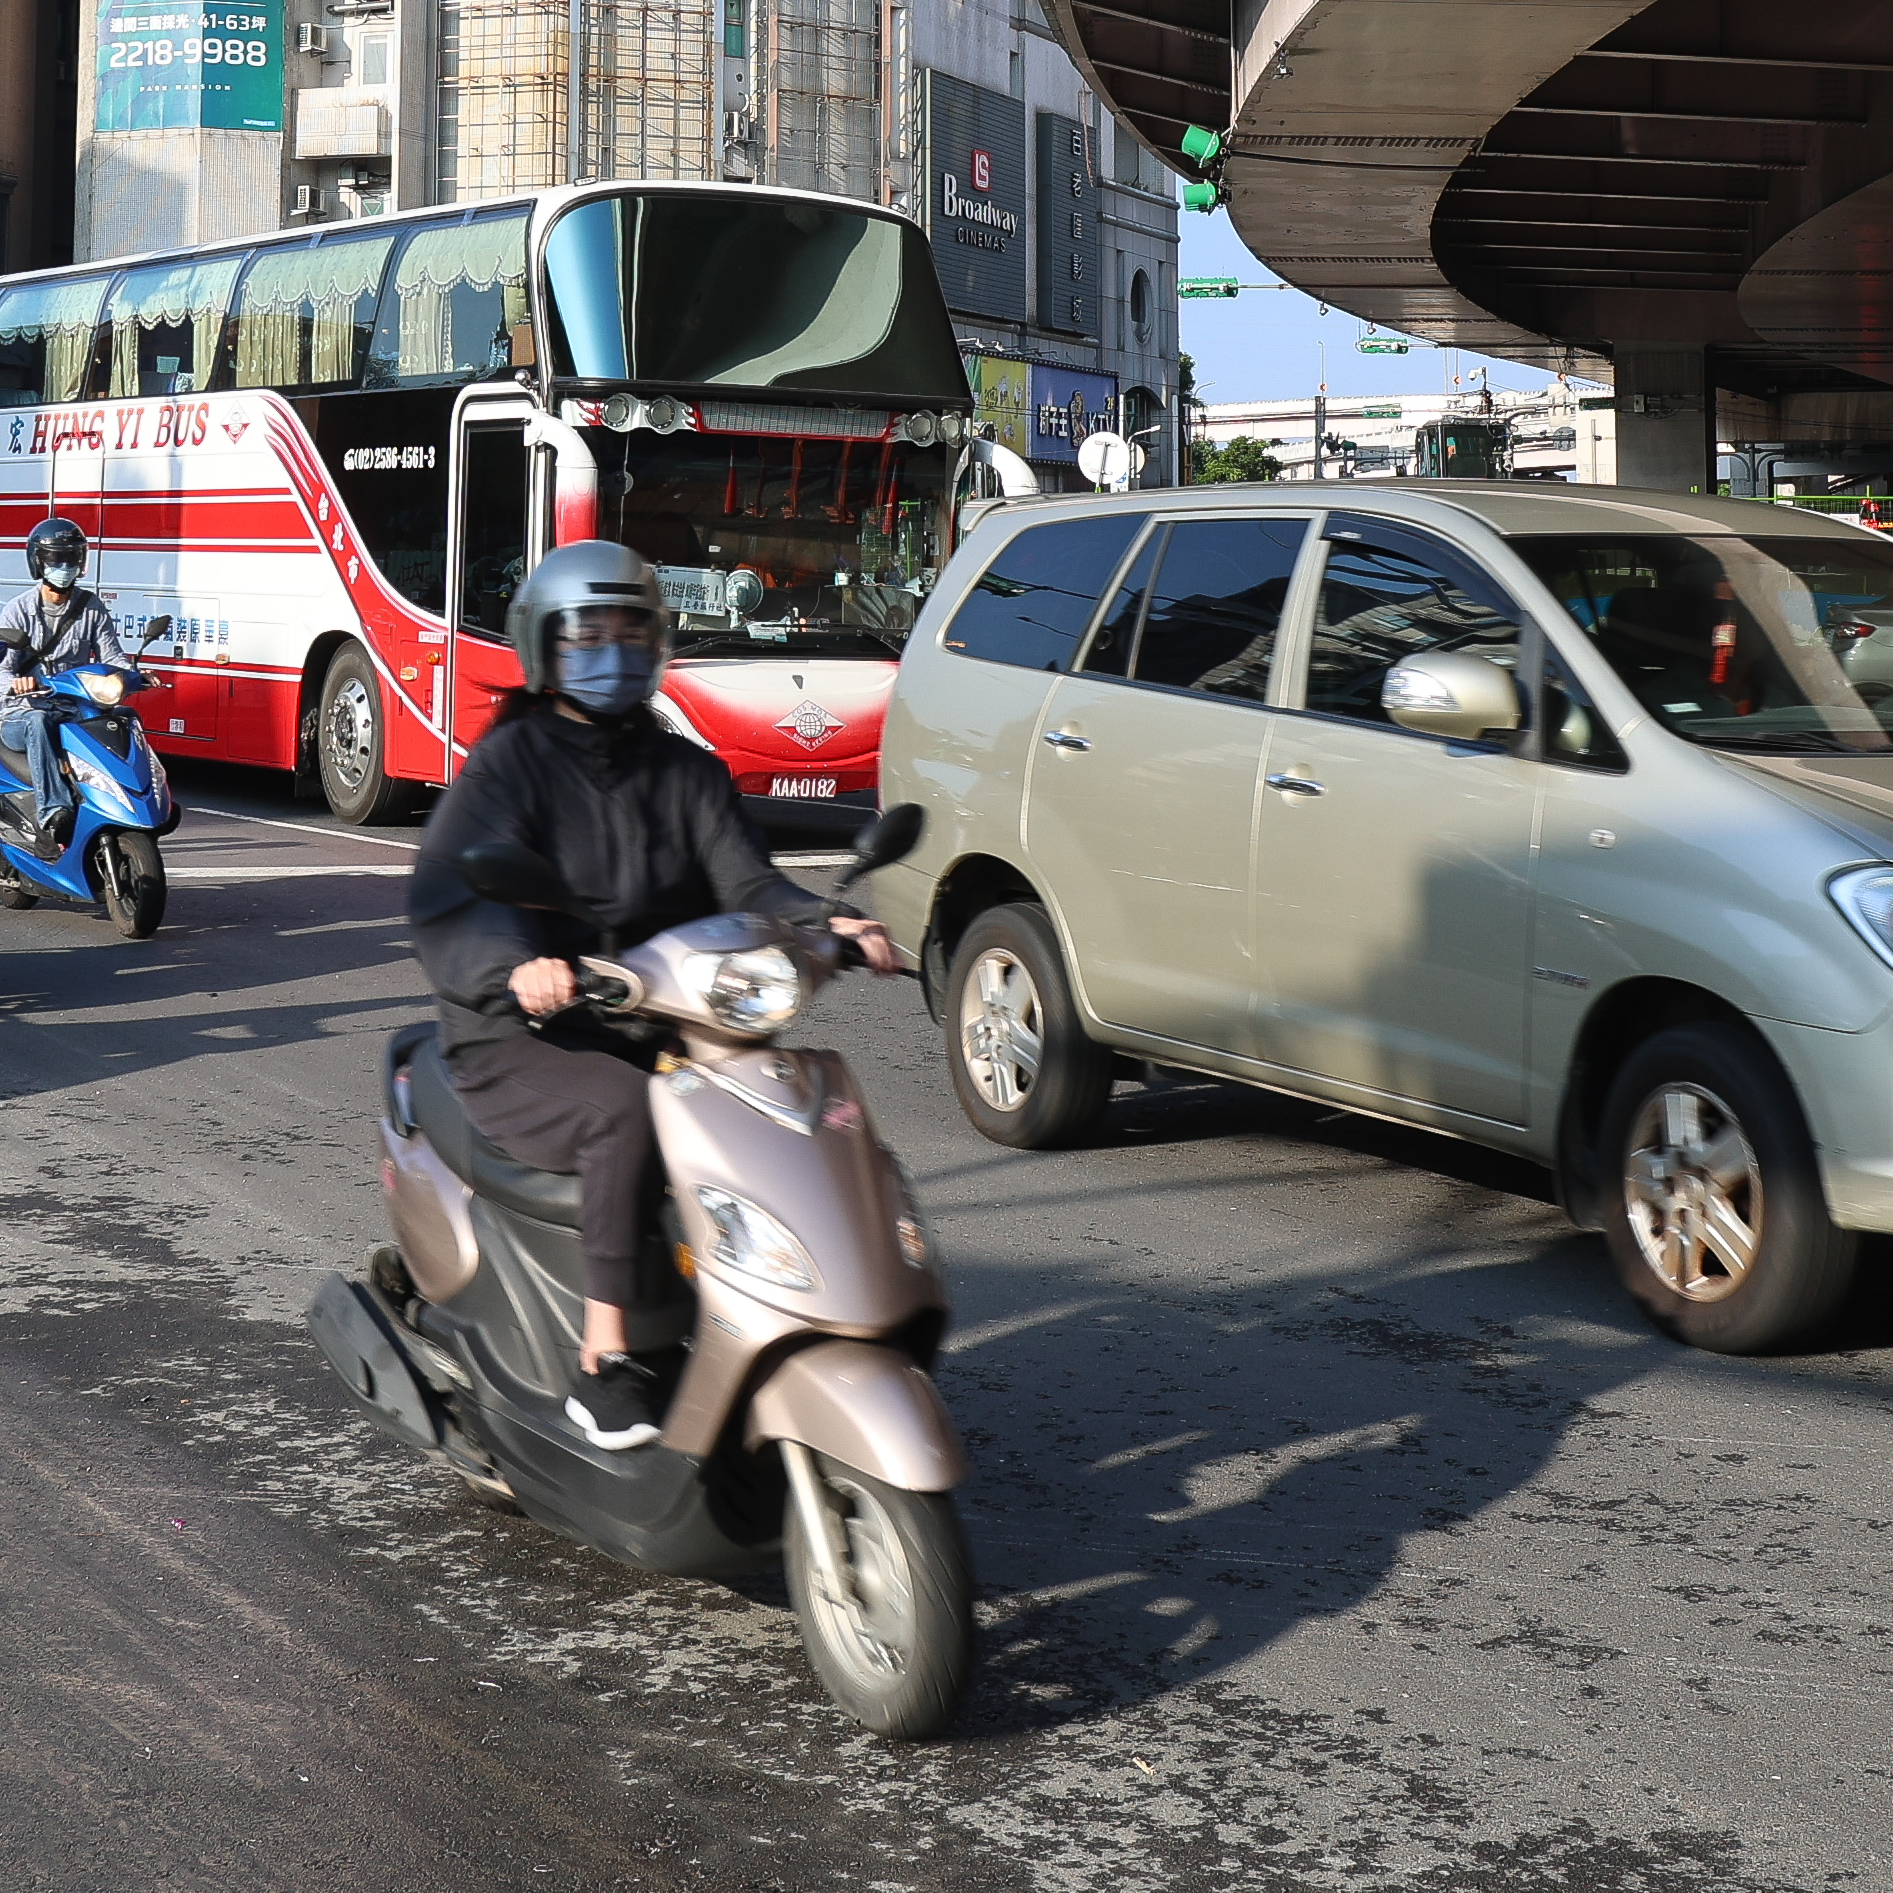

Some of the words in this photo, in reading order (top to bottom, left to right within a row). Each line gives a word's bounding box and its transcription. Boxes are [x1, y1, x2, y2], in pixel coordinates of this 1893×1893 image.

[109, 38, 267, 68] 2218-9988
[944, 172, 1019, 238] Broadway
[957, 227, 1007, 253] CINEMAS
[29, 409, 105, 455] HUNG
[114, 407, 145, 449] YI
[153, 402, 209, 448] BUS
[1089, 412, 1114, 435] KTV
[317, 493, 360, 586] 台北市
[771, 778, 836, 798] KAA-0182
